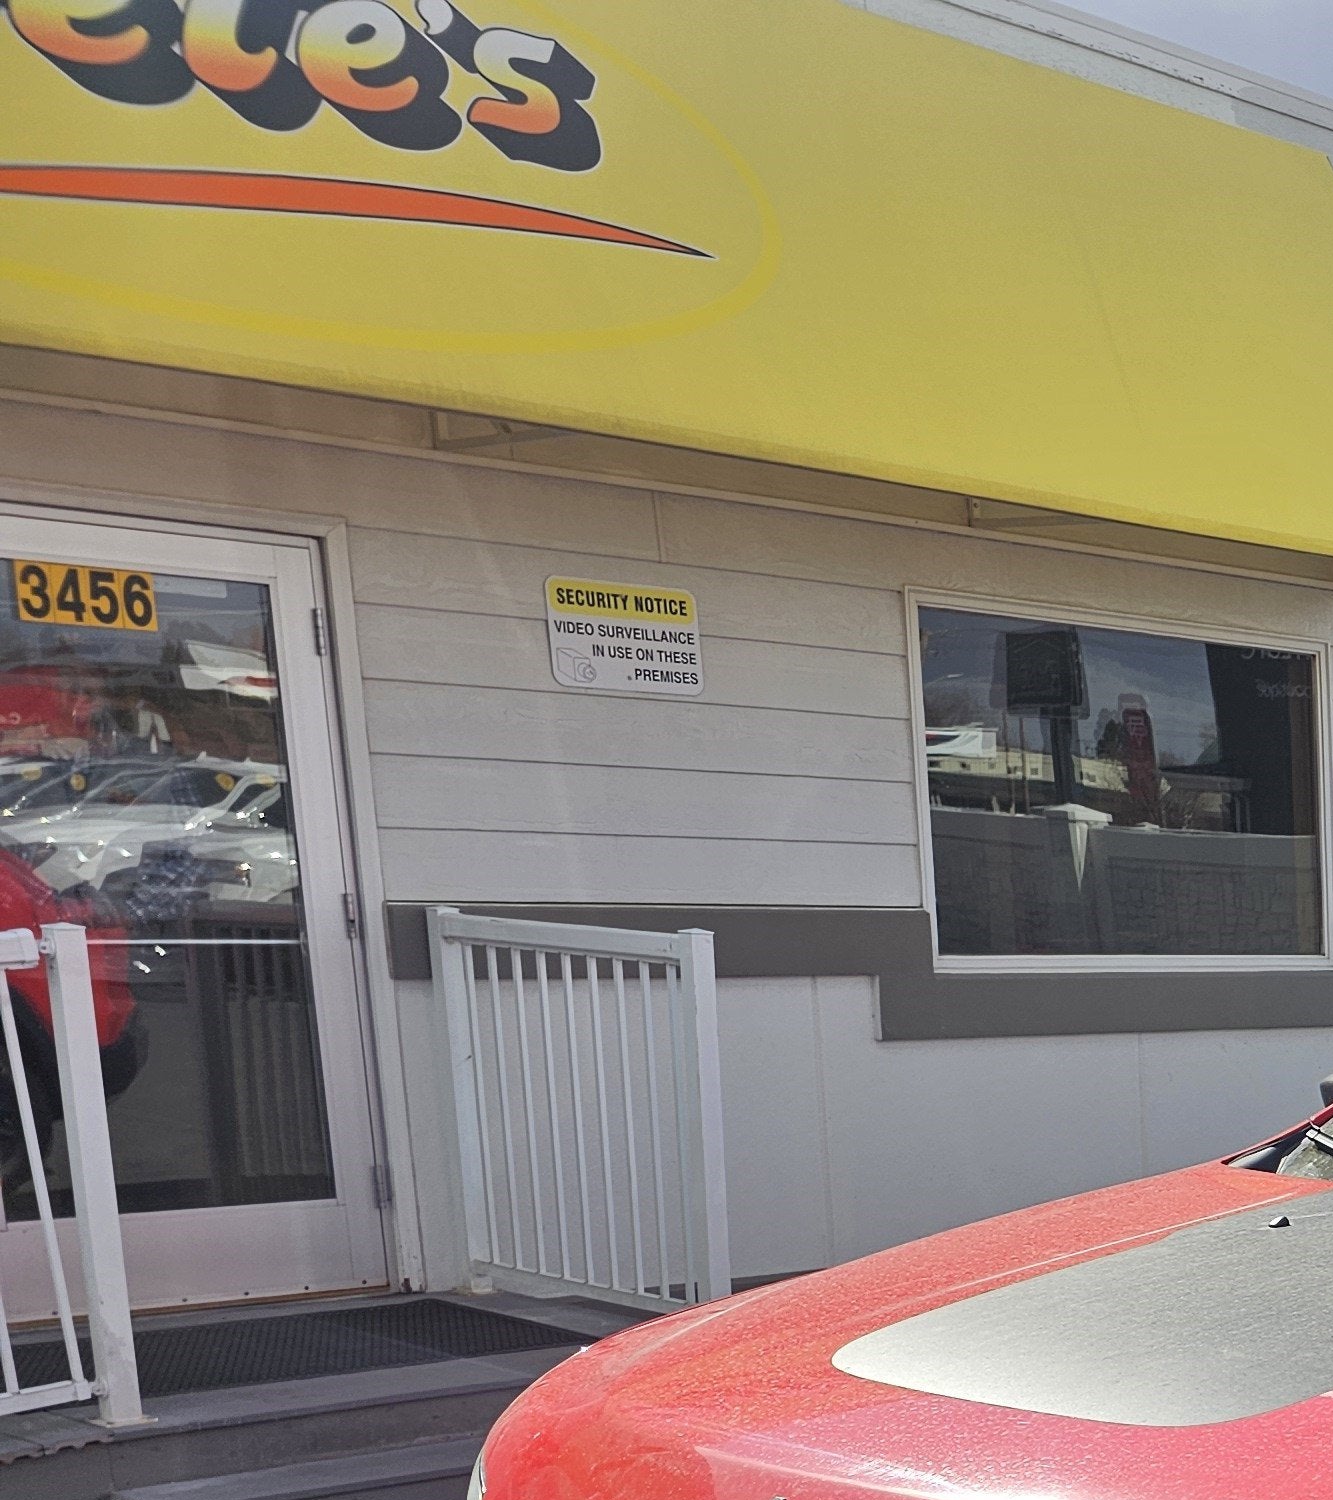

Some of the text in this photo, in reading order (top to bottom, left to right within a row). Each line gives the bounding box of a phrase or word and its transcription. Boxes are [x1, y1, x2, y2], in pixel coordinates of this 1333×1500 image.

[19, 564, 153, 627] 3456
[556, 587, 688, 616] SECURITY NOTICE
[554, 619, 695, 645] VIDEO SURVEILLANCE
[592, 644, 697, 665] IN USE ON THESE
[634, 668, 699, 685] PREMISES
